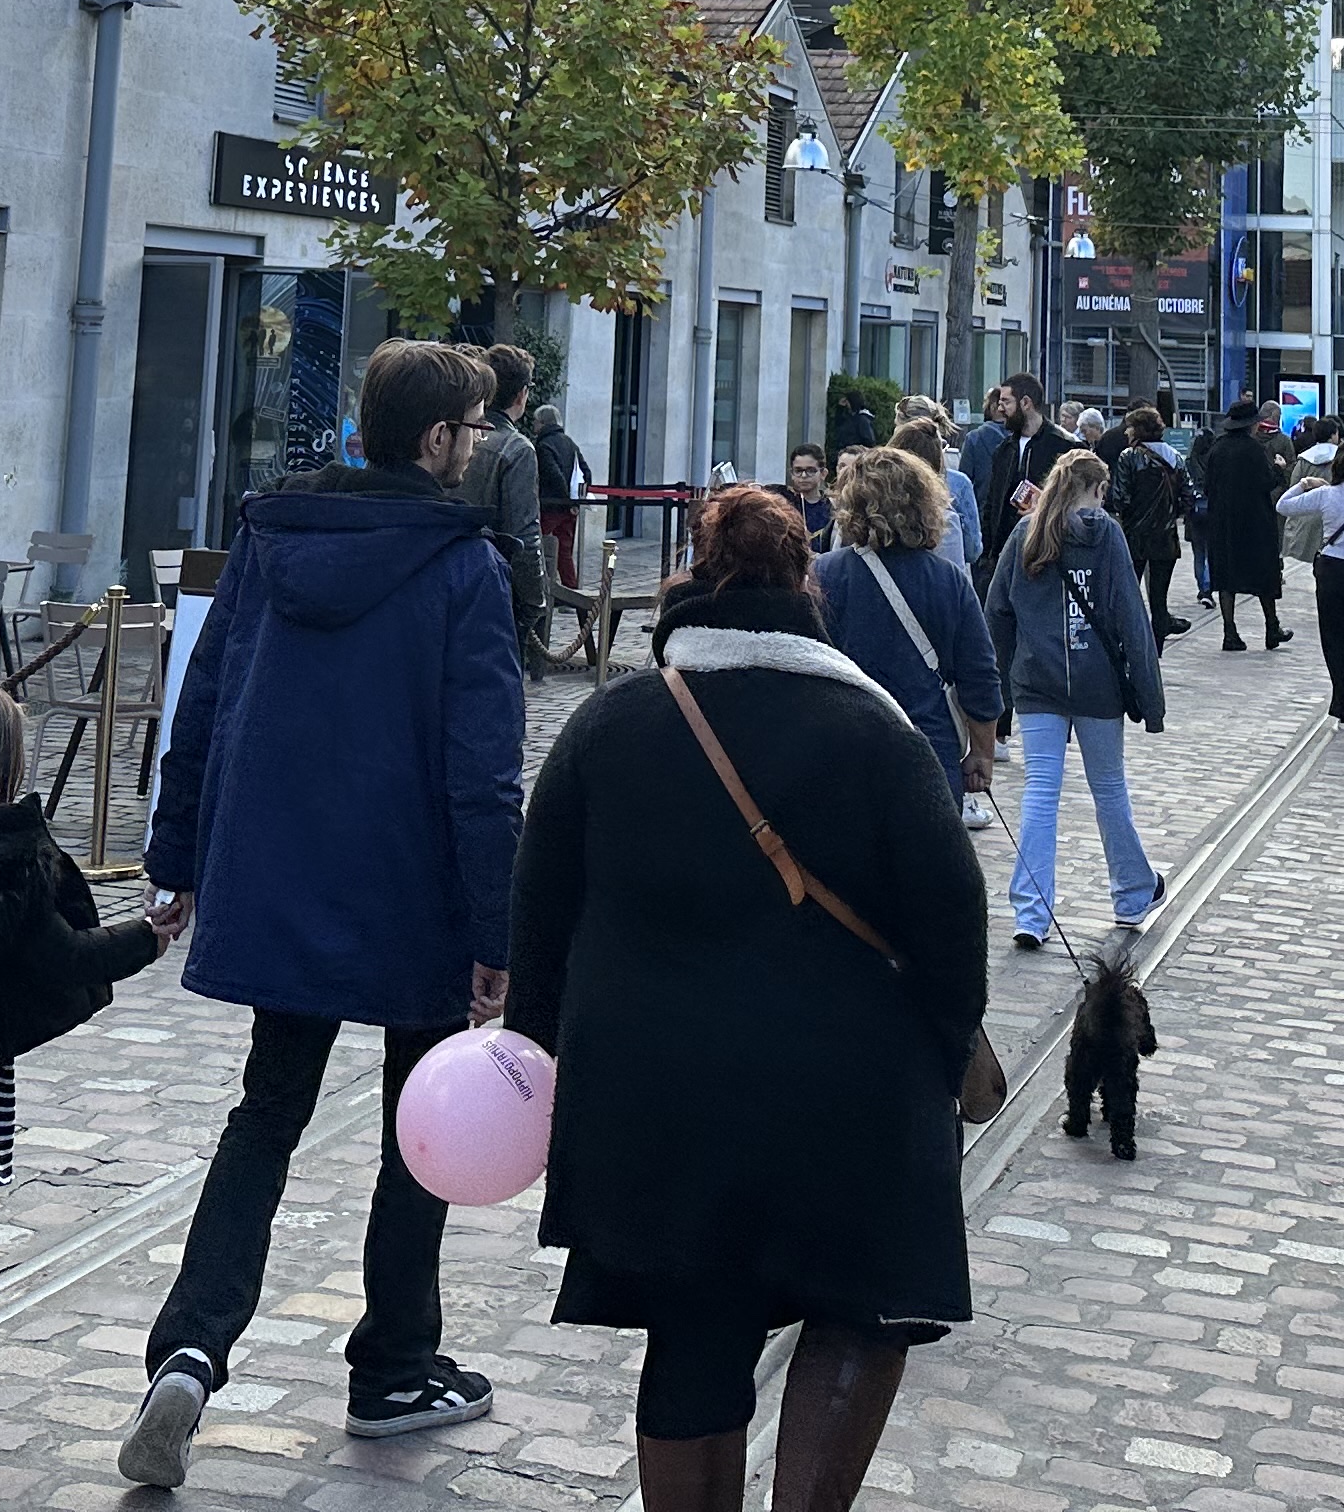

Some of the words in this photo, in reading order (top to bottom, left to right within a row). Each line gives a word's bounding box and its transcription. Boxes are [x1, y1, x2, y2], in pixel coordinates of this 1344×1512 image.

[242, 174, 380, 214] EXPERIENCES
[1076, 295, 1090, 311] AU
[1092, 293, 1131, 312] CINÉMA
[1158, 296, 1205, 314] OCTOBRE
